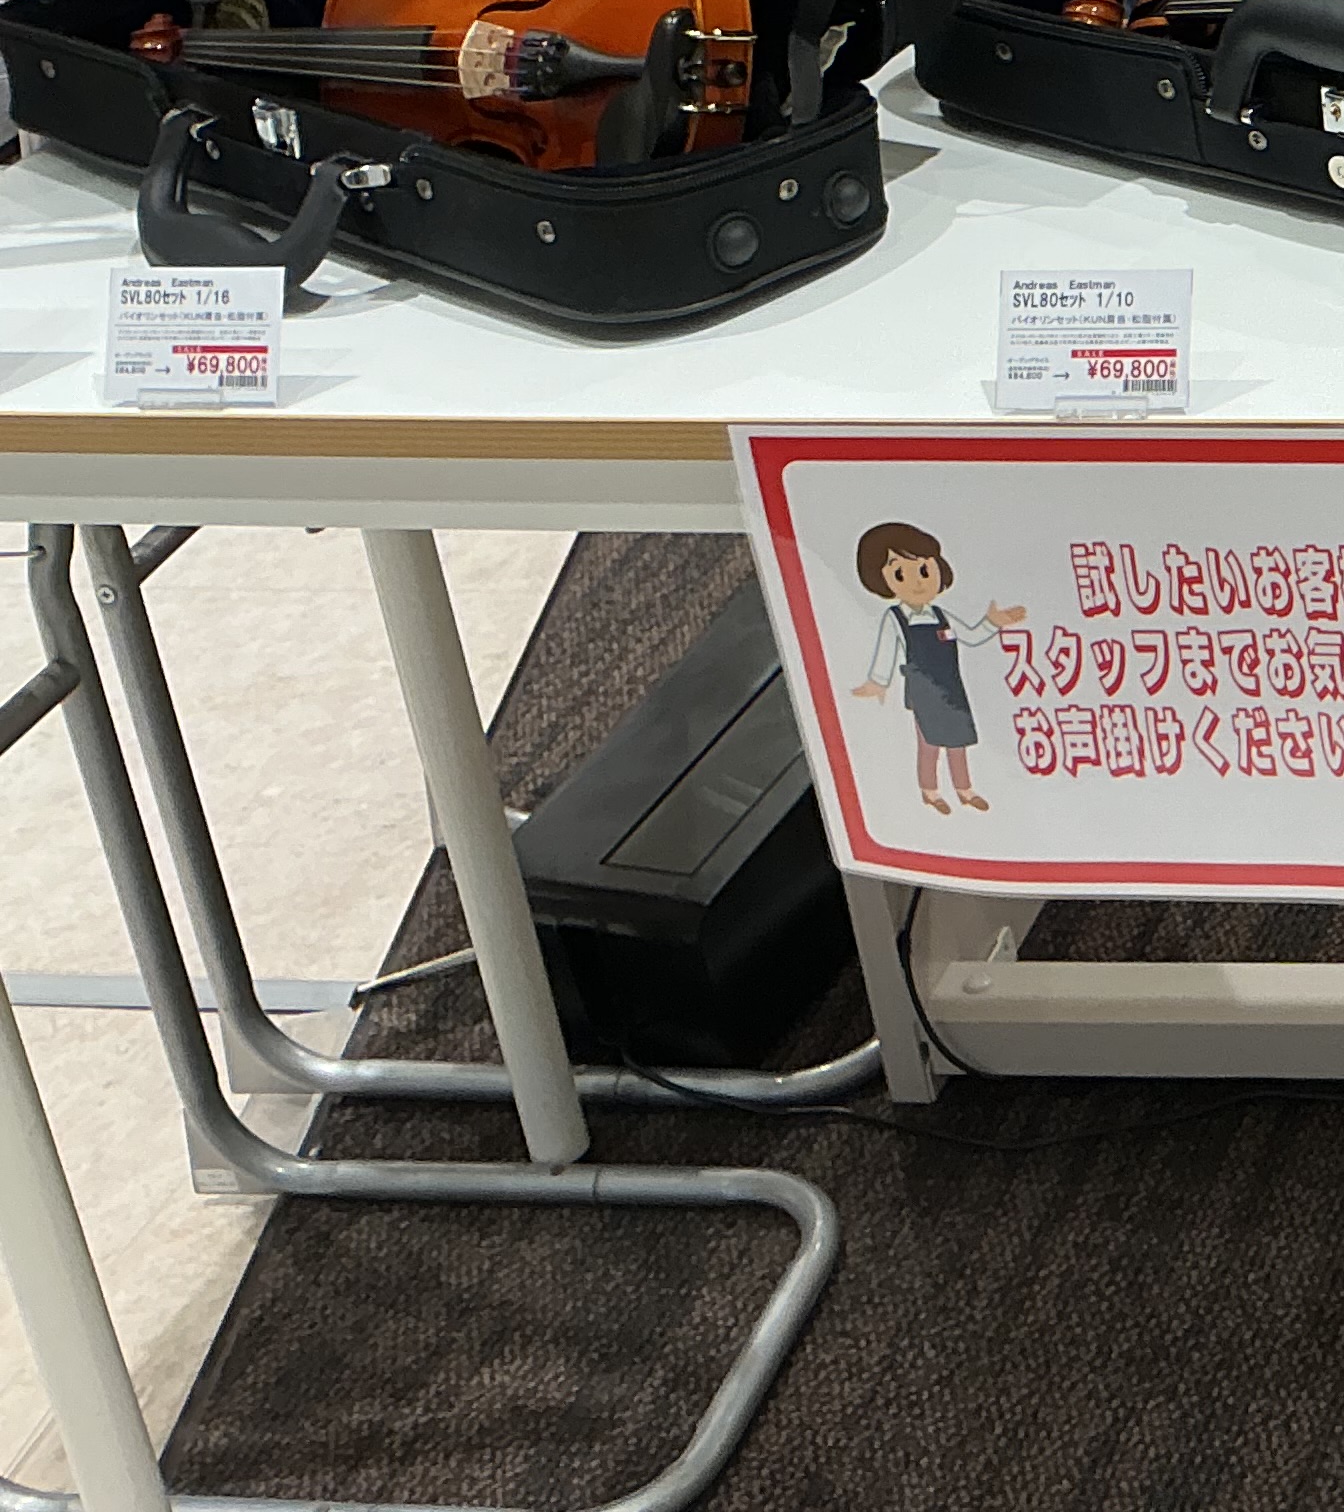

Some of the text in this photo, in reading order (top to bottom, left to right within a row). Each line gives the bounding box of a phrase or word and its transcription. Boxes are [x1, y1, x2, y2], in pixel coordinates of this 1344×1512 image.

[1012, 279, 1058, 290] Andreas
[120, 289, 230, 305] SVL80セット 1/16
[1012, 291, 1135, 308] SVL80セット 1/10
[186, 355, 262, 376] ¥69,800
[1087, 359, 1169, 379] ¥69,800
